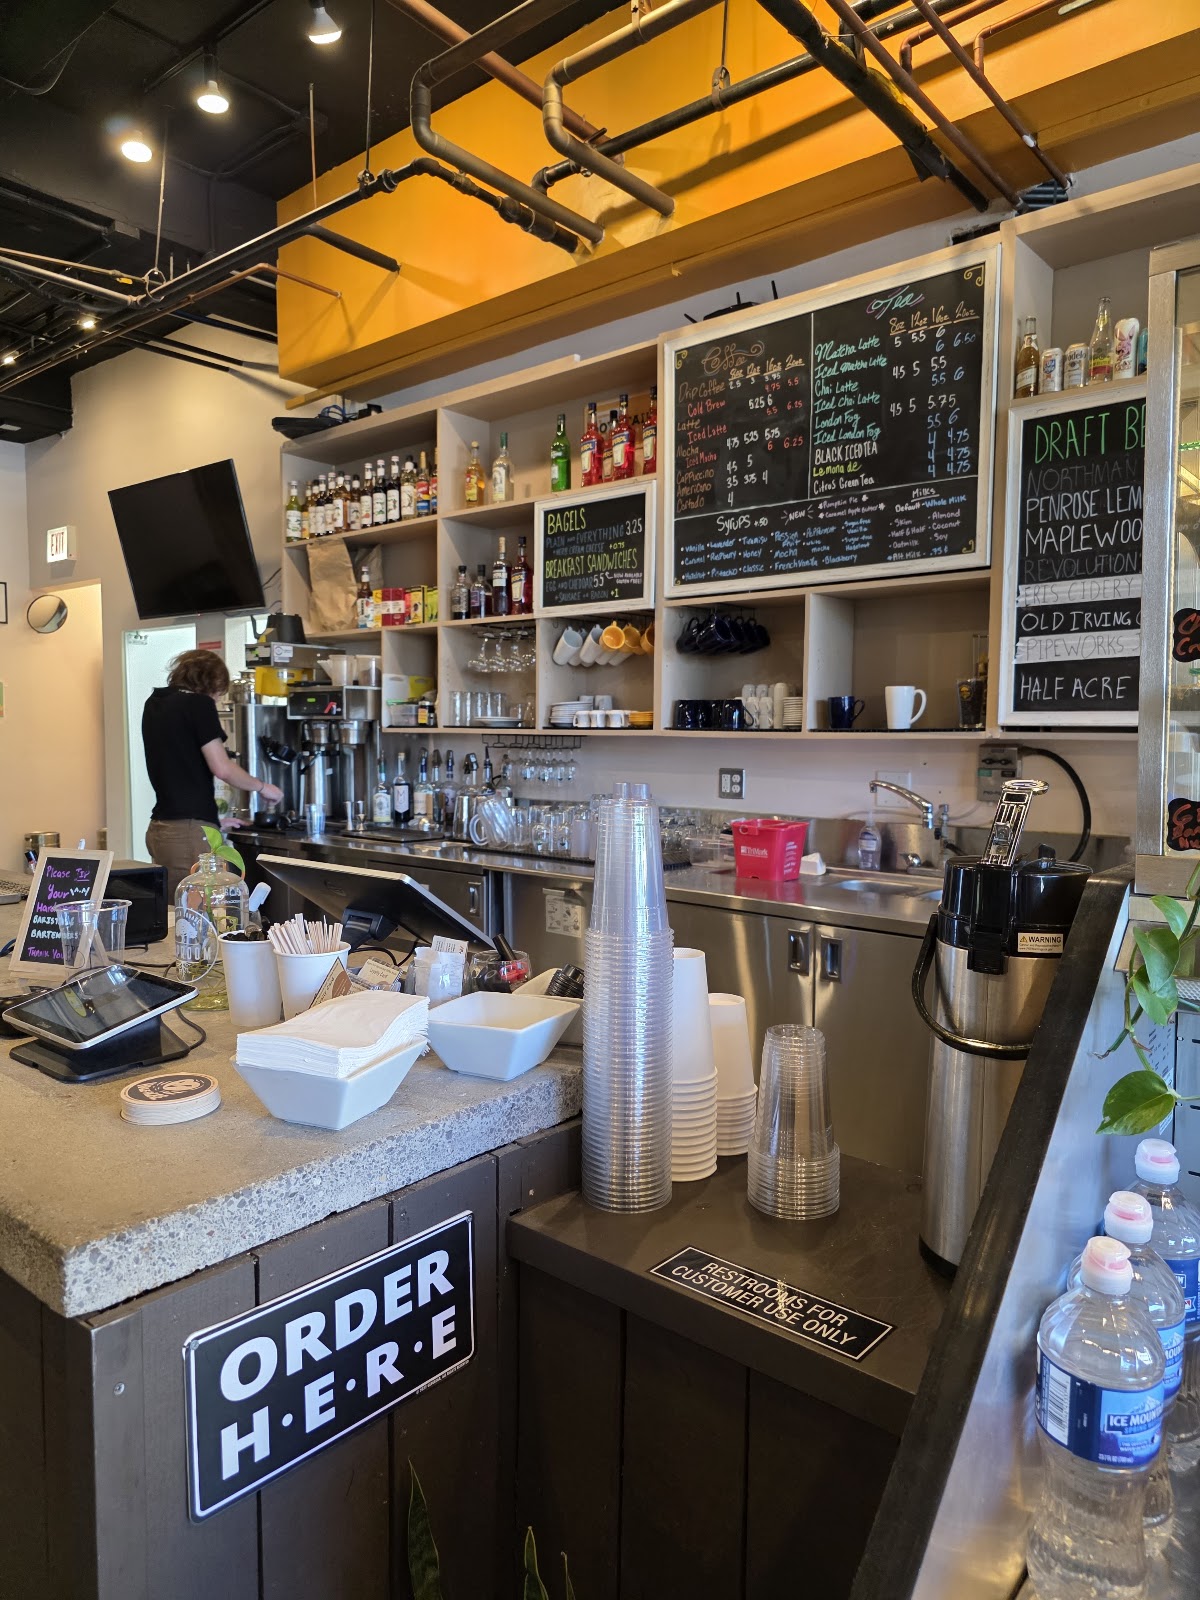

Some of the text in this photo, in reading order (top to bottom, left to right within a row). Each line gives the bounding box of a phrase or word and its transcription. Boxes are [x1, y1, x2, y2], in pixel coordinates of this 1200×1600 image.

[894, 336, 902, 347] 5
[911, 330, 926, 343] 5.5
[936, 325, 946, 338] 6
[935, 339, 945, 352] 6
[912, 360, 920, 376] 5
[930, 355, 947, 372] 5.5
[750, 376, 756, 385] 3
[931, 372, 946, 387] 5.5
[953, 366, 965, 381] 6
[687, 402, 703, 418] Cold
[705, 398, 726, 412] Brew
[767, 394, 773, 406] 6
[908, 398, 917, 413] 5
[927, 393, 956, 410] 5.75
[948, 407, 960, 425] 6
[767, 440, 774, 451] 6
[783, 436, 804, 449] 6.25
[815, 428, 970, 466] BLACK ICED TEA 4 4.75
[1034, 412, 1111, 464] DRAFT
[747, 454, 753, 467] 5
[928, 449, 935, 464] 4
[947, 446, 971, 461] 4.75
[762, 470, 768, 484] 4
[928, 464, 936, 478] 4
[947, 460, 971, 476] 4.75
[1027, 456, 1138, 499] NORTHMAN
[728, 491, 734, 507] 4
[1026, 488, 1100, 525] PENROSE
[547, 507, 586, 535] BAGELS
[788, 510, 806, 521] NEW
[576, 523, 625, 544] EVERYTHING
[625, 517, 643, 536] 3.25
[933, 533, 948, 542] Soy
[50, 531, 65, 557] EXIT
[545, 547, 638, 579] BREAKFAST SANDWICHES
[1024, 552, 1138, 583] REVOLUTION
[1024, 576, 1135, 607] ERIS CIDERY
[1020, 611, 1065, 632] OLD
[1069, 611, 1132, 632] IRVING
[1026, 635, 1124, 662] PIPEWORKS
[1020, 672, 1132, 702] HALF ACRE
[46, 865, 71, 878] Please
[47, 883, 70, 900] Your
[701, 1261, 849, 1328] RESTROOMS FOR
[671, 1265, 858, 1347] CUSTOMER USE ONLY
[220, 1249, 454, 1402] ORDER
[1109, 1414, 1129, 1427] ICE
